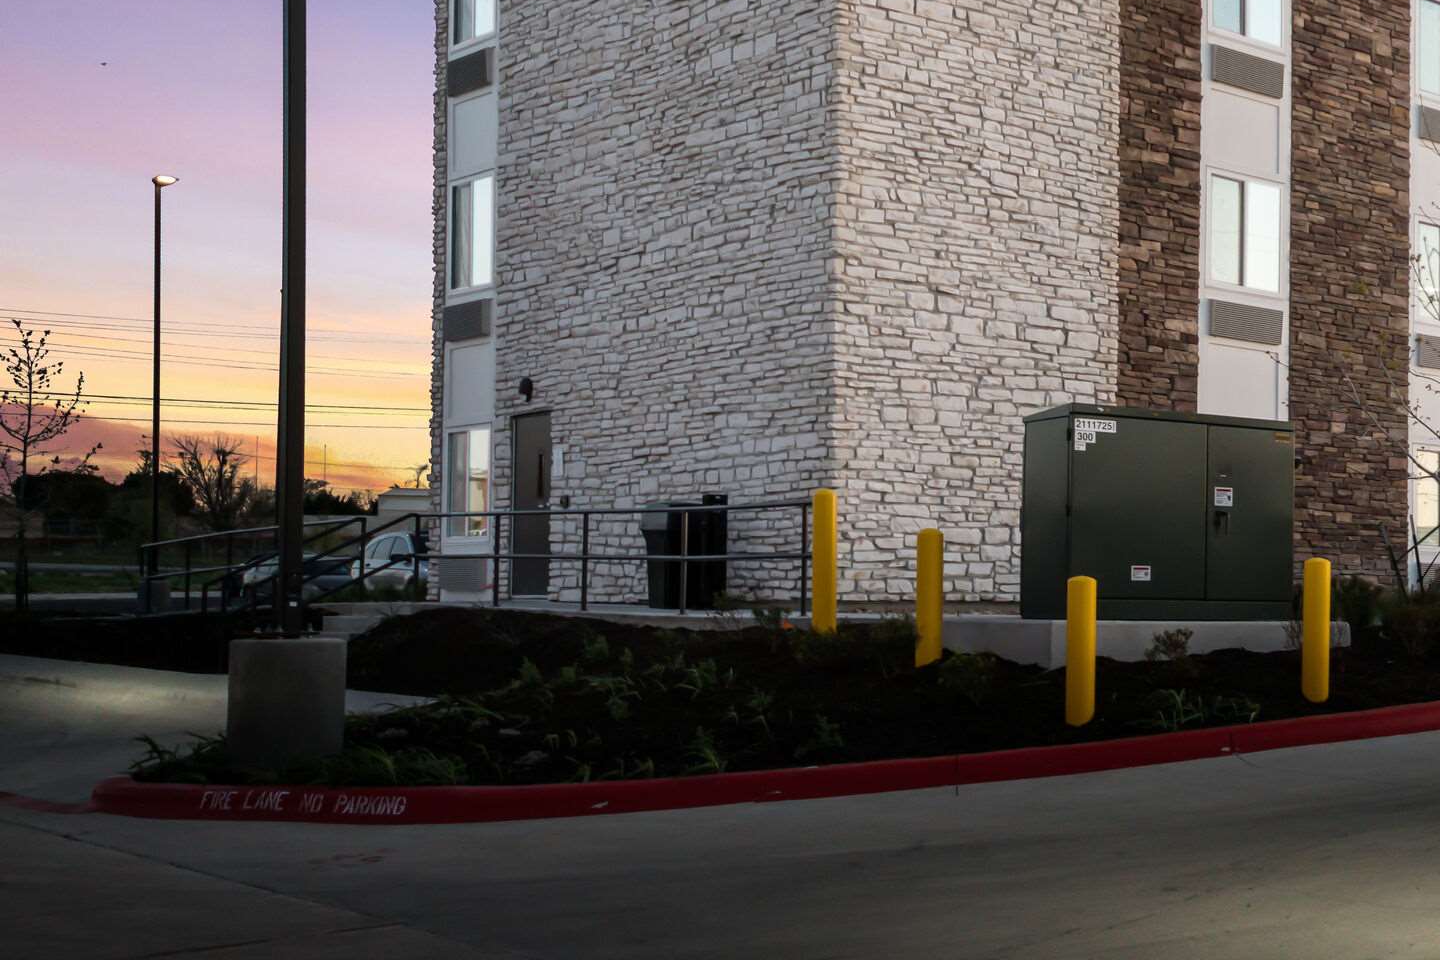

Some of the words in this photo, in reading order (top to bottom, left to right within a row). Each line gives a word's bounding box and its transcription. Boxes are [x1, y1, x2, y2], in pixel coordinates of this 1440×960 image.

[1077, 431, 1094, 442] 300
[199, 791, 239, 810] FIRE
[243, 790, 290, 811] LANE
[297, 793, 325, 813] NO
[333, 794, 408, 816] PARKING
